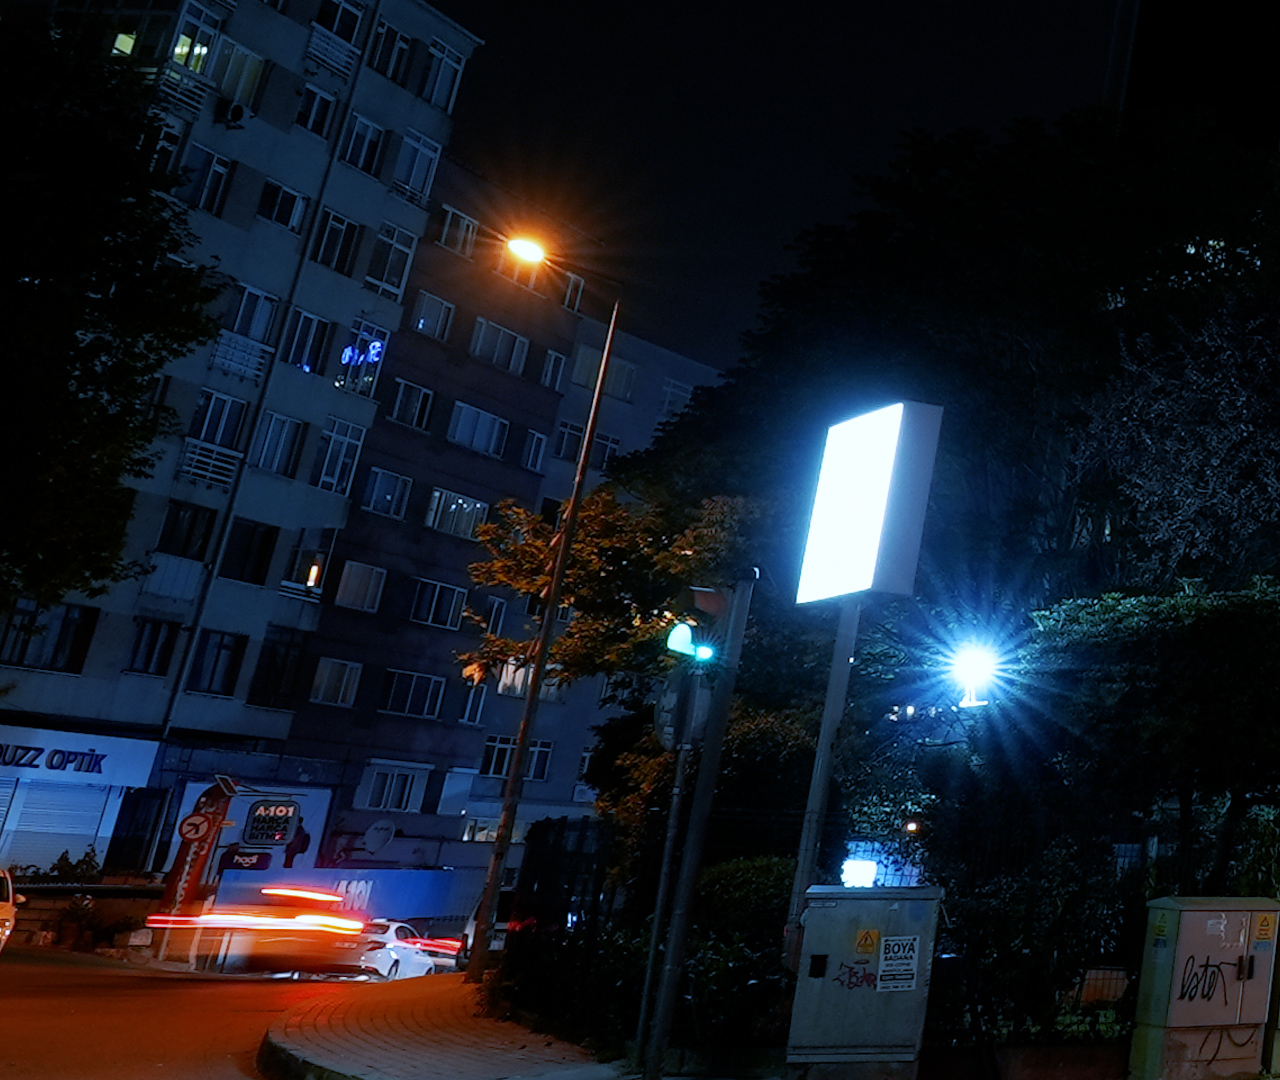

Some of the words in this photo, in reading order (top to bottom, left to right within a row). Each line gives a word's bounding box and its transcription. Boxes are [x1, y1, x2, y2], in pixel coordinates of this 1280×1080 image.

[0, 743, 45, 769] UZZ
[45, 748, 108, 774] OPTİK
[883, 942, 916, 955] BOYA
